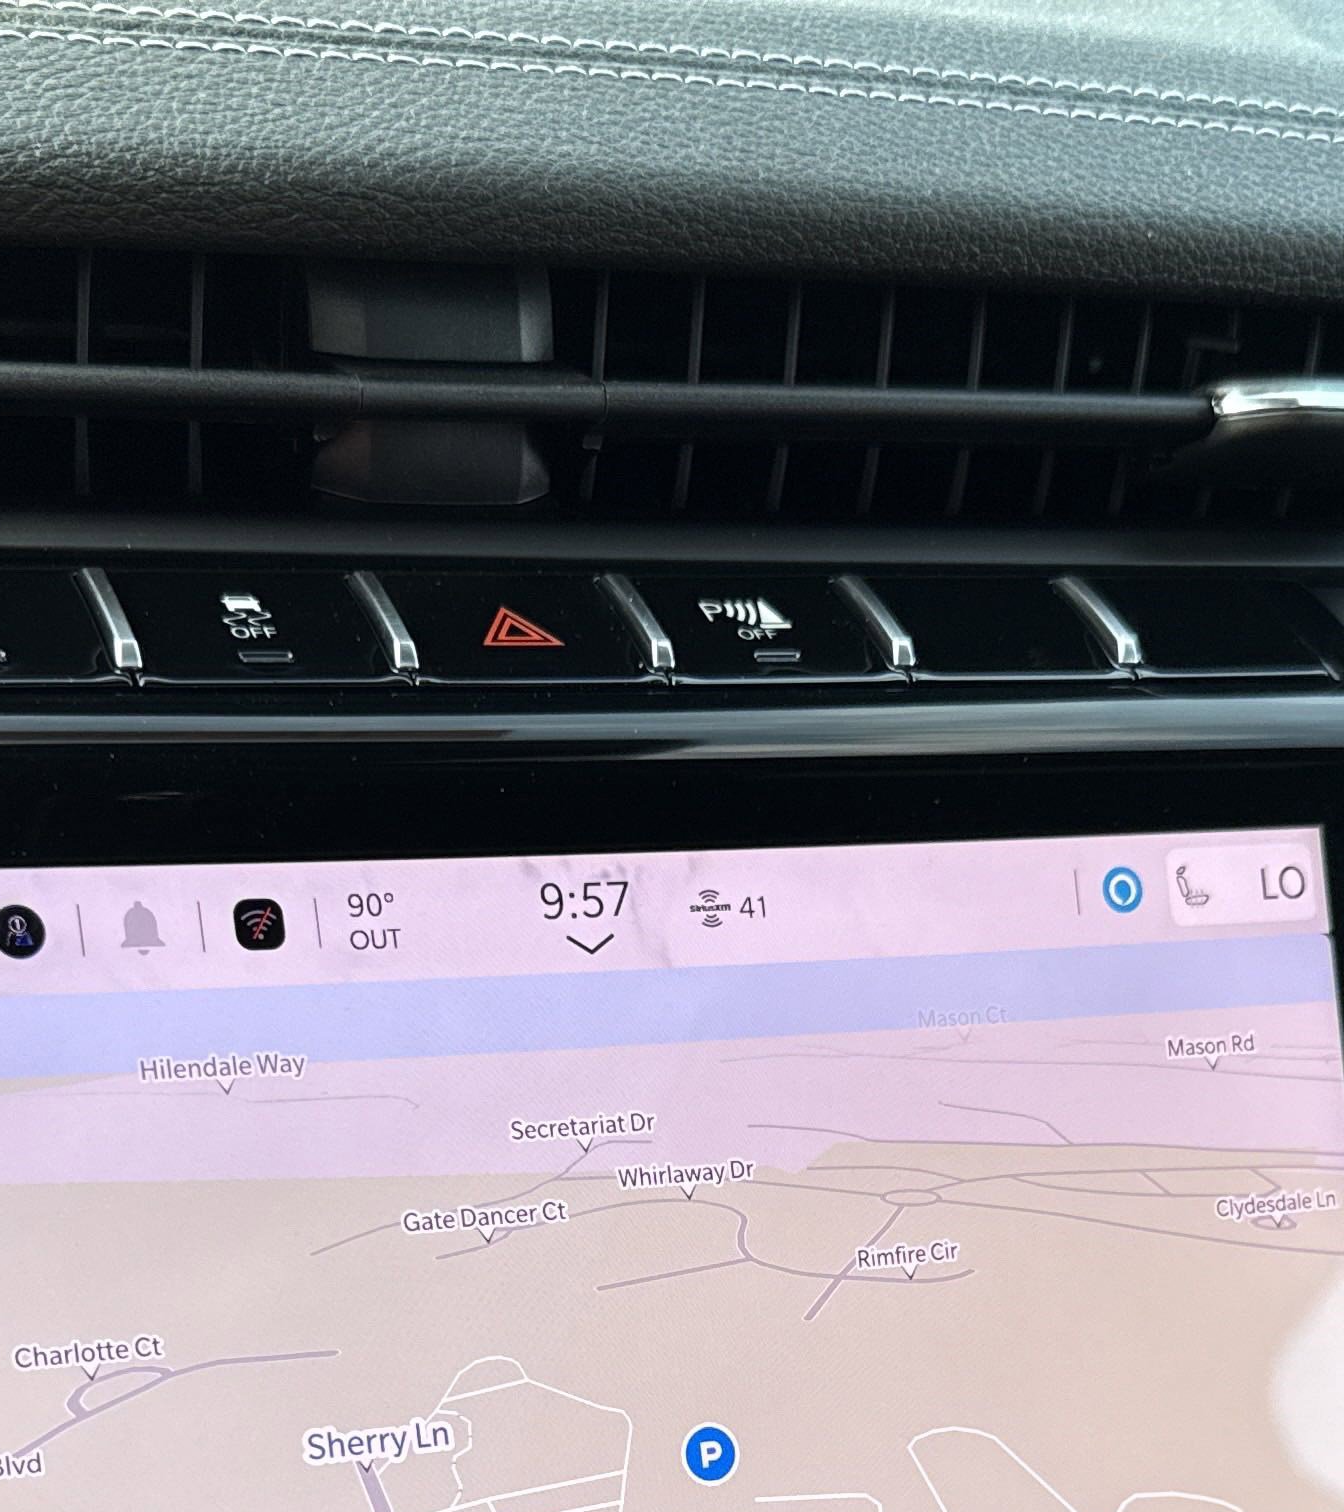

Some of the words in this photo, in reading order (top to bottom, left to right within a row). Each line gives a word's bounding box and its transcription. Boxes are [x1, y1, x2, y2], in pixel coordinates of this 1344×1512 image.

[229, 625, 278, 640] OFF
[736, 627, 780, 642] OFF
[1259, 865, 1307, 901] LO
[346, 891, 396, 919] 90°
[539, 880, 630, 921] 9:57
[739, 895, 766, 919] 41
[349, 927, 402, 951] OUT
[917, 1007, 983, 1029] Mason
[986, 1005, 1008, 1026] Ct
[1167, 1036, 1228, 1058] Mason
[1232, 1032, 1256, 1053] Rd
[138, 1055, 253, 1082] Hilendale
[256, 1052, 306, 1079] Way
[510, 1114, 627, 1142] Secretariat
[630, 1112, 656, 1133] Dr
[616, 1162, 725, 1190] Whirlaway
[729, 1160, 755, 1181] Dr
[402, 1209, 457, 1234] Gate
[460, 1203, 538, 1229] Dancer
[541, 1200, 568, 1222] Ct
[1215, 1192, 1313, 1219] Clydesdale
[1315, 1189, 1337, 1210] Ln
[856, 1243, 927, 1270] Rimfire
[930, 1241, 960, 1263] Cir
[13, 1338, 131, 1370] Charlotte
[133, 1335, 163, 1360] Ct
[306, 1428, 408, 1463] Sherry
[414, 1421, 451, 1452] Ln
[699, 1440, 723, 1469] P
